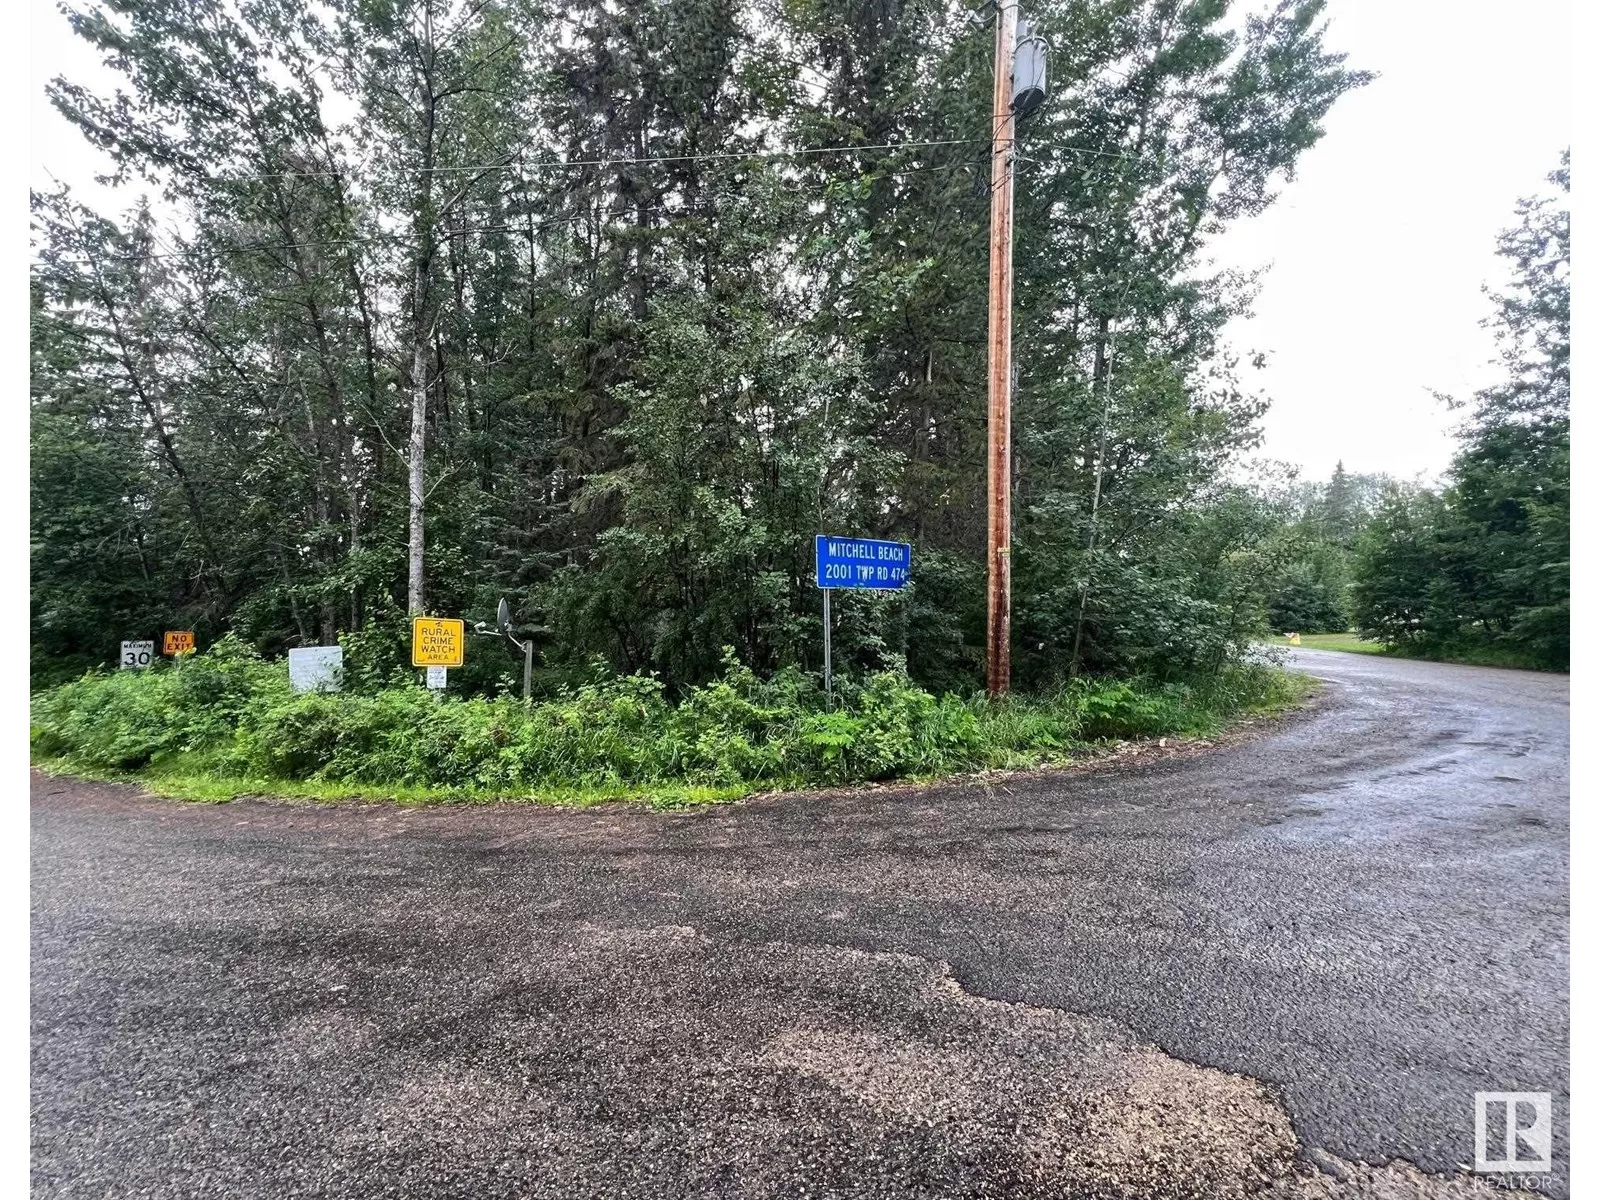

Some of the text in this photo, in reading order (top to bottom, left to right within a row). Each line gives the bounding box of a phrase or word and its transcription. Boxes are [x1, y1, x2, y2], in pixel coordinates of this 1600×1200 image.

[828, 542, 904, 562] MITCHELL BEACH
[825, 564, 905, 581] 2001 TWP RD 474
[421, 627, 456, 637] RURAL
[423, 636, 454, 645] CRIME
[167, 643, 191, 651] EXIT
[421, 645, 456, 654] WATCH
[124, 652, 150, 665] 30
